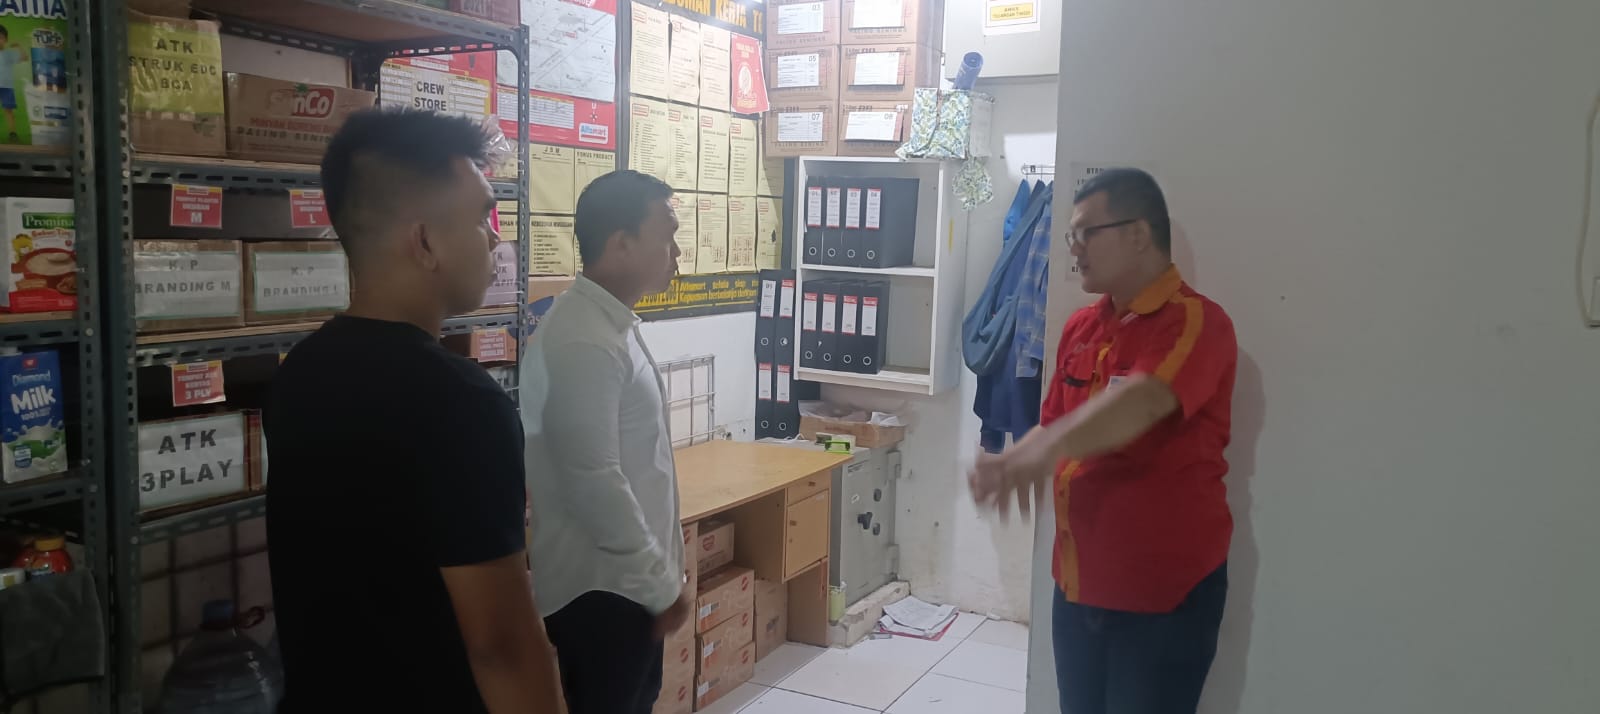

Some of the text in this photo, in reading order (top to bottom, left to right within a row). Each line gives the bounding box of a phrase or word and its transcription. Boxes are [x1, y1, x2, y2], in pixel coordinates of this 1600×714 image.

[156, 39, 193, 54] ATK
[128, 56, 217, 76] STRUK EDC
[161, 79, 192, 91] BCA
[416, 81, 444, 95] CREW
[414, 97, 447, 112] STORE
[25, 215, 74, 229] Promina
[191, 212, 202, 223] M
[309, 213, 317, 224] L
[135, 280, 232, 294] BRANDING M
[264, 286, 329, 297] BRANDING
[10, 385, 57, 414] Milk
[185, 388, 212, 400] 3 PLY
[158, 429, 217, 455] ATK
[141, 459, 233, 492] 3PLAY
